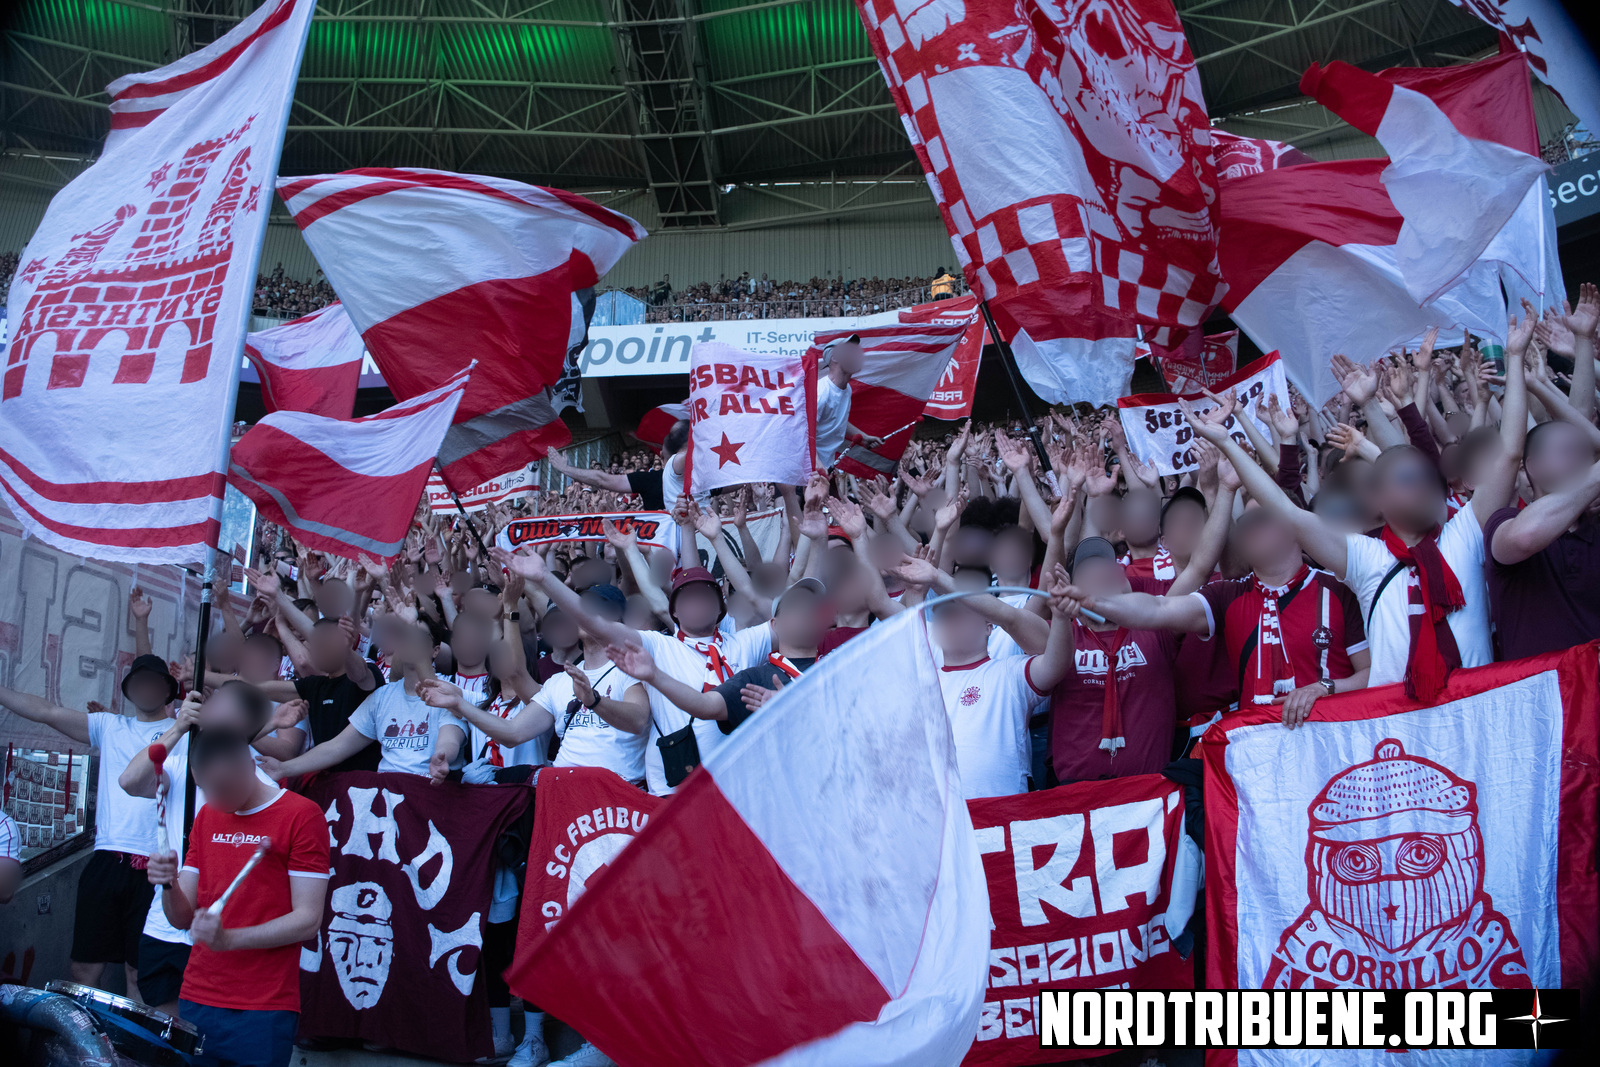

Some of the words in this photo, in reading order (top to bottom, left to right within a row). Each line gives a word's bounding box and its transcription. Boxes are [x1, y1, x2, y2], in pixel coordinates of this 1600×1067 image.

[1549, 170, 1600, 208] ec
[719, 394, 795, 416] ALLE
[546, 844, 571, 880] SC
[1305, 936, 1483, 989] CORRILLO
